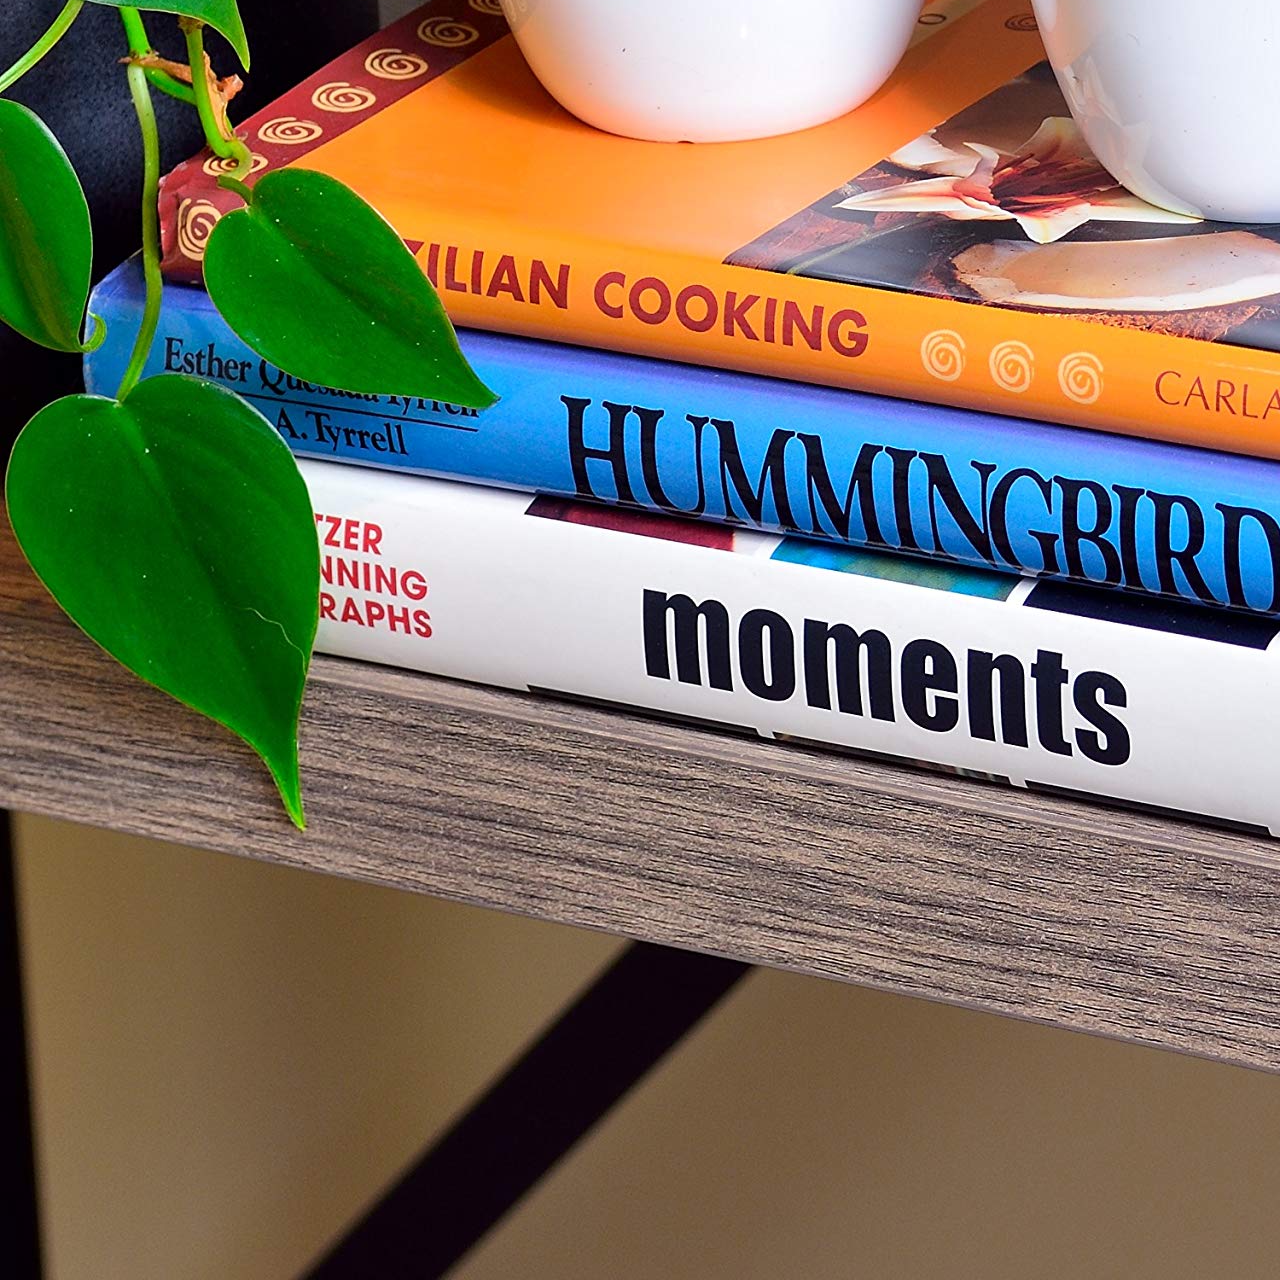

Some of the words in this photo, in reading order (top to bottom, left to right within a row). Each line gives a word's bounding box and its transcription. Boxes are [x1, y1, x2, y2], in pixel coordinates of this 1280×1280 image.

[593, 271, 869, 359] COOKING
[164, 336, 253, 383] Esther
[305, 410, 409, 456] Tyrrell
[642, 587, 1131, 767] moments
